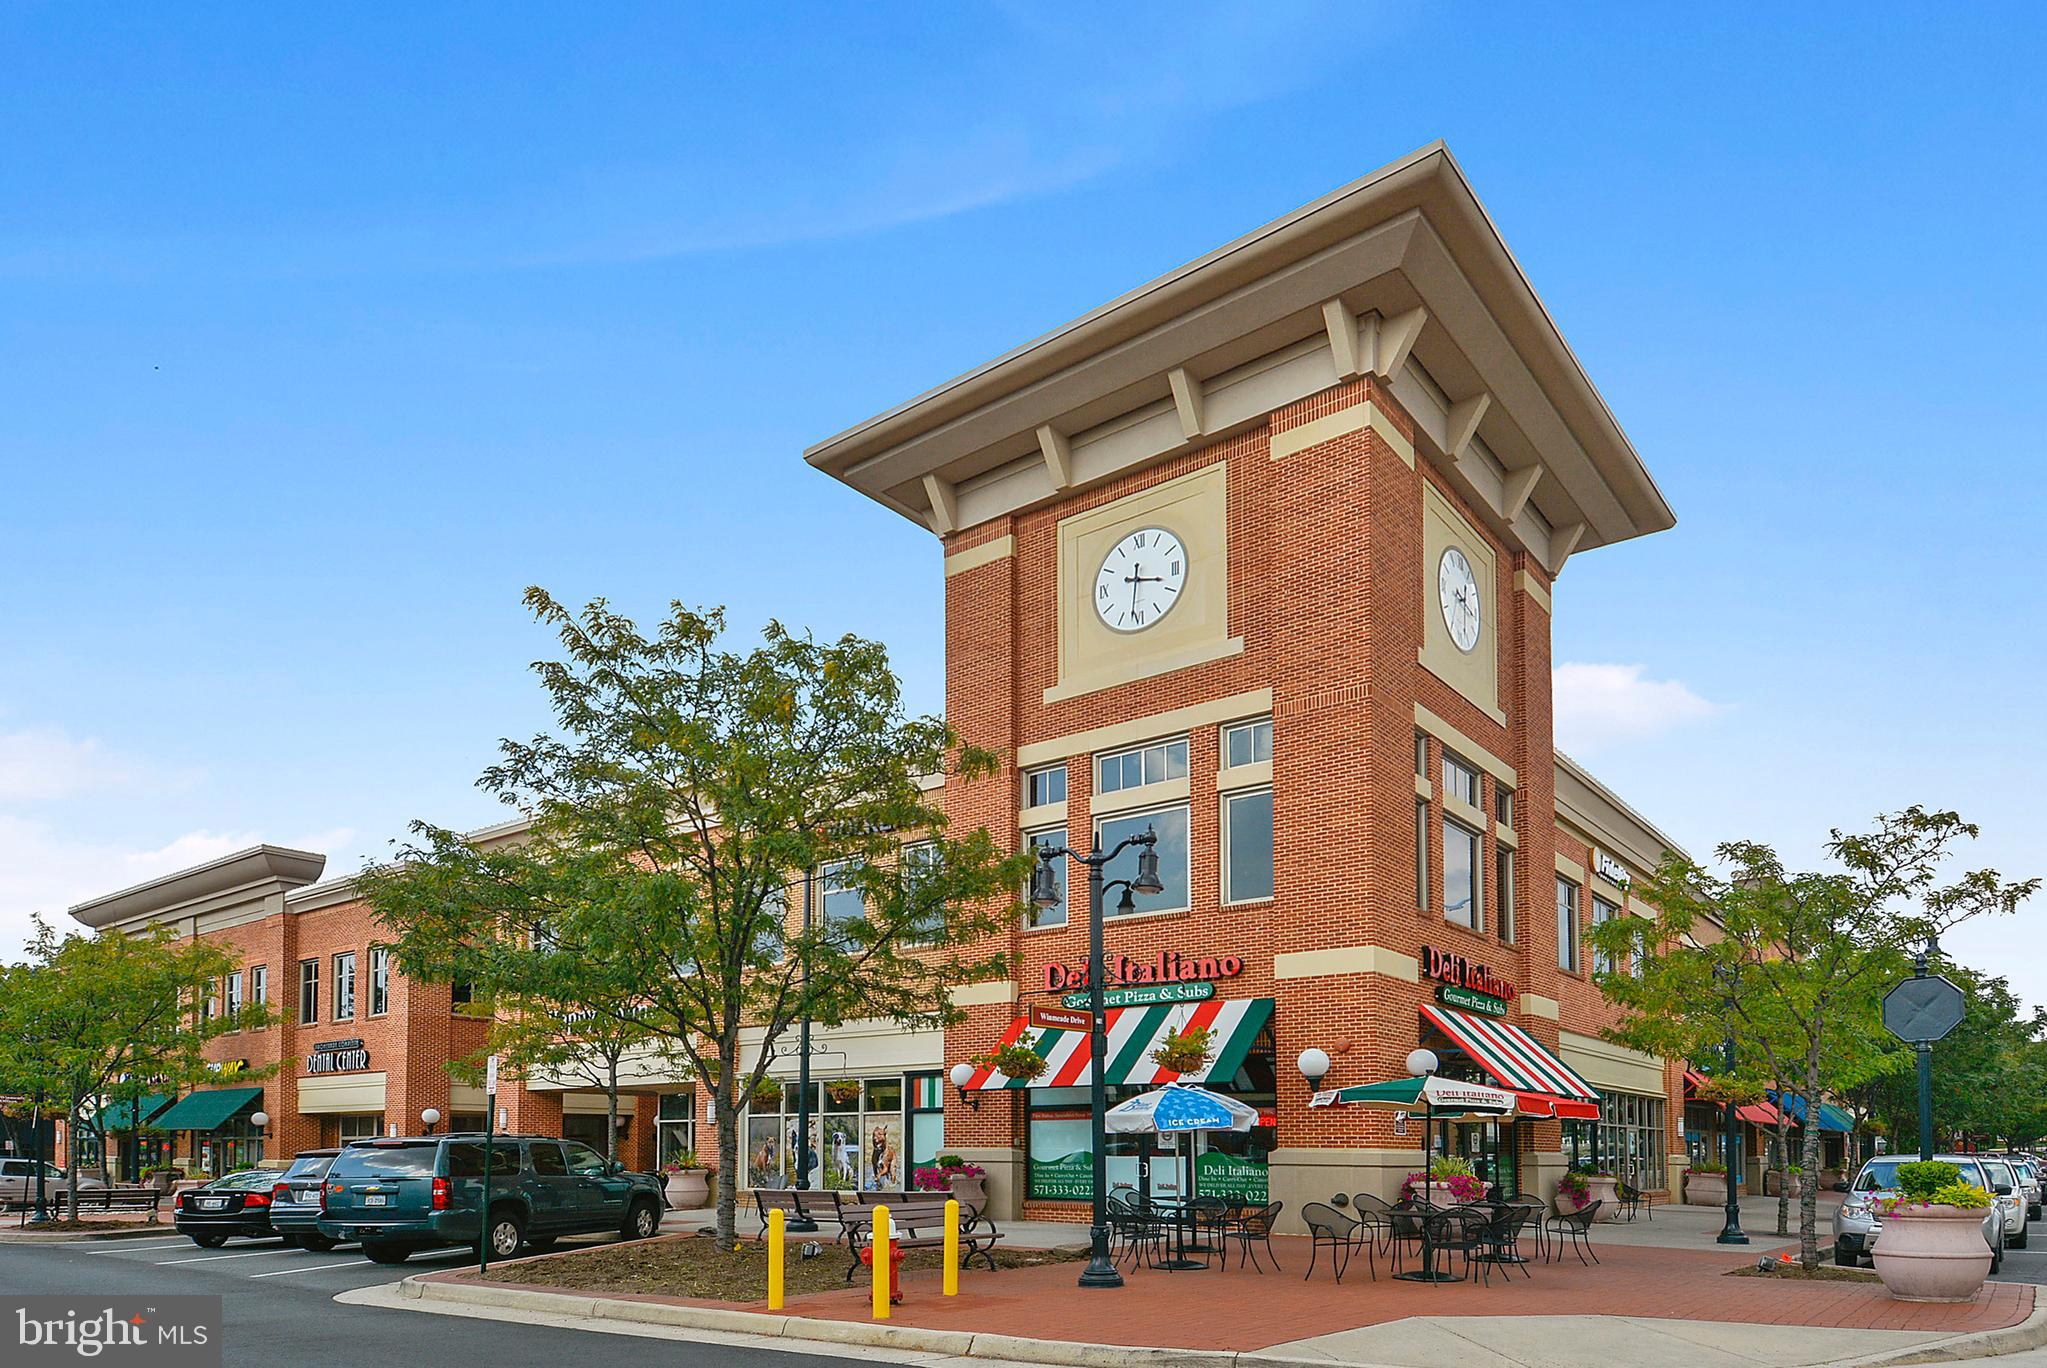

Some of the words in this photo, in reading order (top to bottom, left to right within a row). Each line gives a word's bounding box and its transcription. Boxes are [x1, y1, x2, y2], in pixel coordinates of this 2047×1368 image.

[1042, 957, 1091, 991] Del
[1113, 950, 1241, 983] Italiano
[1428, 945, 1461, 984] Deli
[1464, 957, 1516, 1000] Italiano
[1124, 990, 1156, 1003] Pizza
[1159, 987, 1174, 1000] &
[1177, 985, 1208, 998] Subs
[1443, 988, 1470, 1007] Gourmet
[1471, 996, 1486, 1010] Pizza
[1486, 1001, 1492, 1012] &
[1493, 1002, 1506, 1016] Subs
[1040, 1012, 1069, 1023] Winmeade
[1070, 1015, 1085, 1025] Drive
[306, 1052, 335, 1073] DENTAL
[336, 1049, 367, 1071] CENTER
[1168, 1119, 1184, 1127] ICE
[1186, 1117, 1220, 1126] CREAM
[1258, 1116, 1277, 1127] PEN
[1204, 1165, 1225, 1176] Deli
[1228, 1165, 1268, 1177] Italiano
